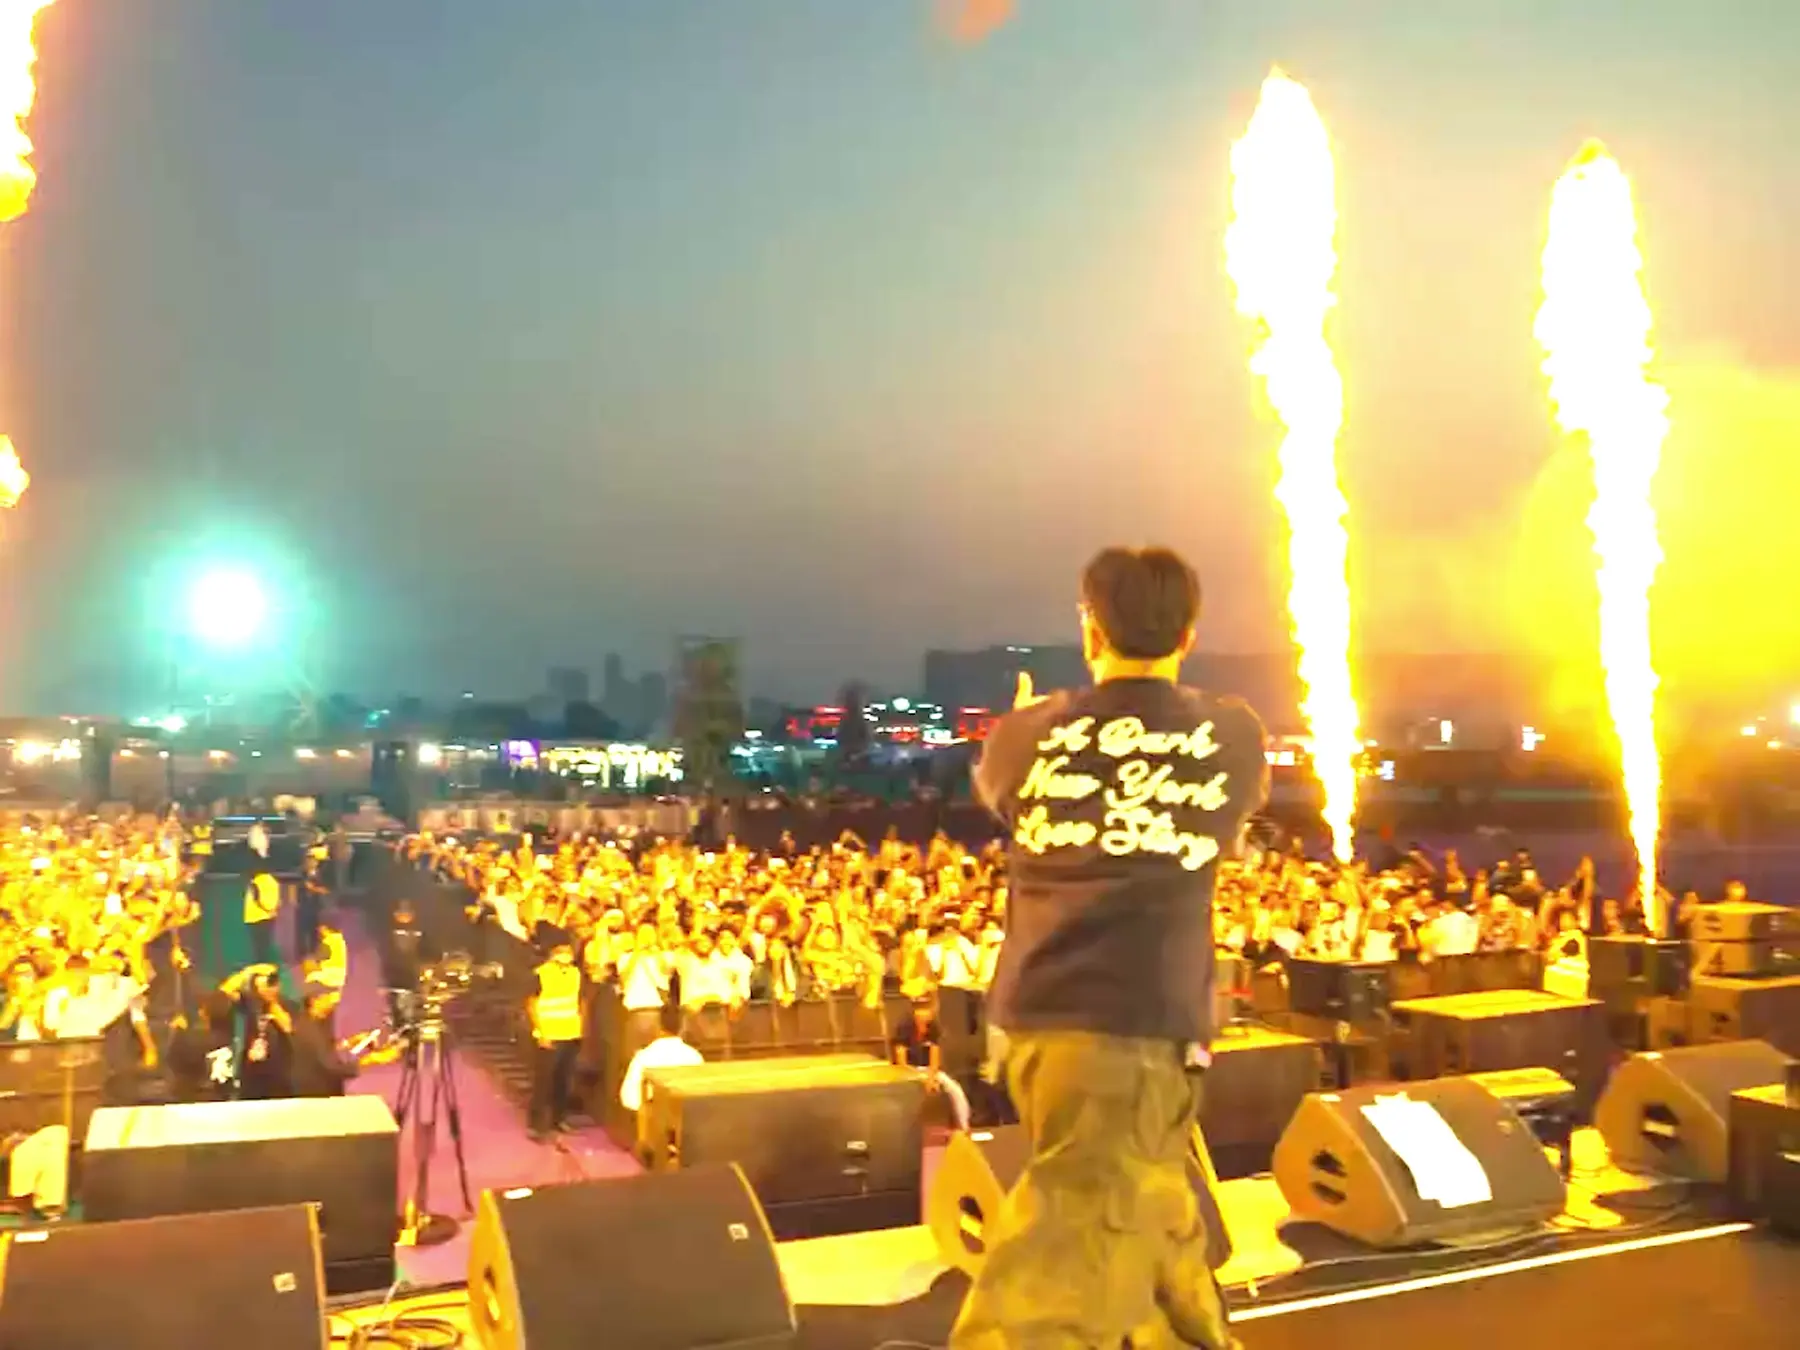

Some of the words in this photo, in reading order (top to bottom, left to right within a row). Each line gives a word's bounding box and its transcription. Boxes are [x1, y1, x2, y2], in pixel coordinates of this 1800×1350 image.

[1098, 716, 1220, 759] Dark
[1019, 756, 1100, 798] New
[1105, 760, 1229, 810] York
